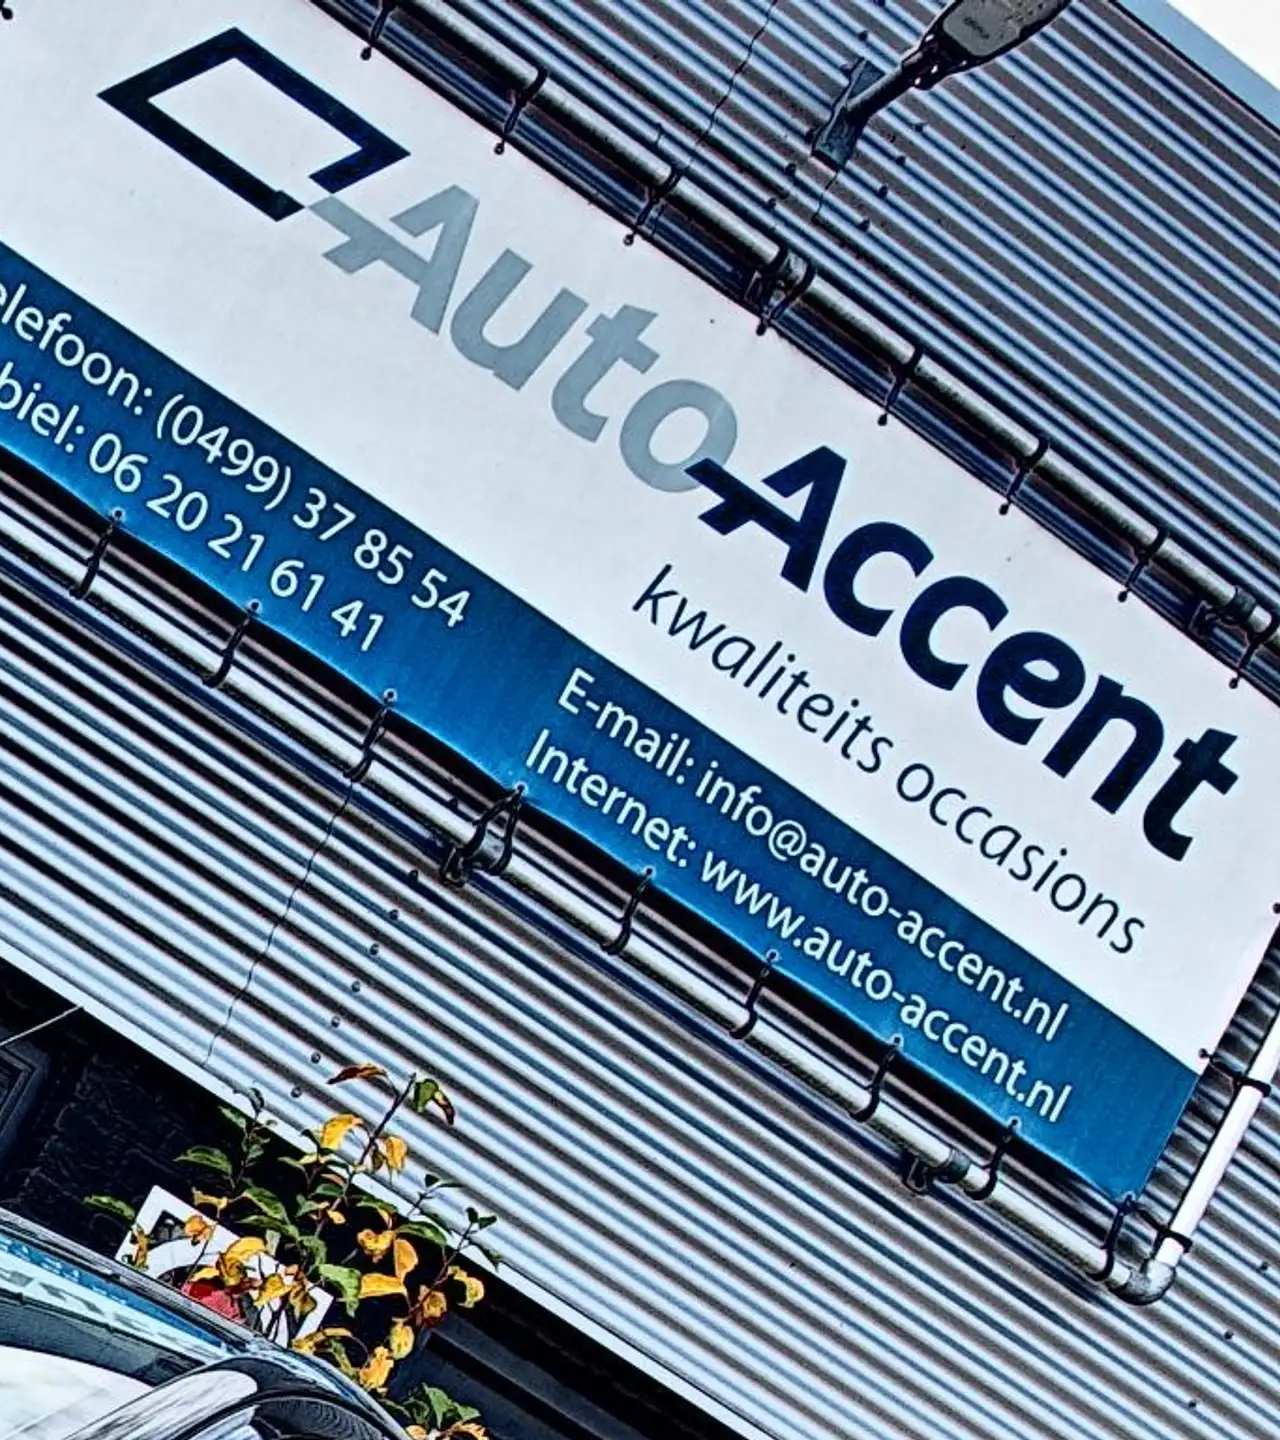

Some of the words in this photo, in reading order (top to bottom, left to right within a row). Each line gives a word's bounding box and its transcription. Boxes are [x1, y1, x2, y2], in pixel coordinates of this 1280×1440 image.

[88, 433, 148, 492] 06
[146, 474, 208, 531] 20
[208, 514, 265, 572] 21
[270, 559, 325, 612] 61
[330, 600, 384, 652] 41
[156, 393, 292, 511] (0499)
[293, 487, 357, 541] 37
[354, 528, 413, 584] 85
[411, 568, 471, 628] 54
[526, 729, 697, 867] Internet:
[702, 851, 1072, 1122] www.auto-accent.nl
[558, 667, 697, 785] E-mail:
[695, 764, 1069, 1041] info@auto-accent.nl
[632, 564, 895, 774] kwaliteits
[896, 763, 1145, 954] occasions
